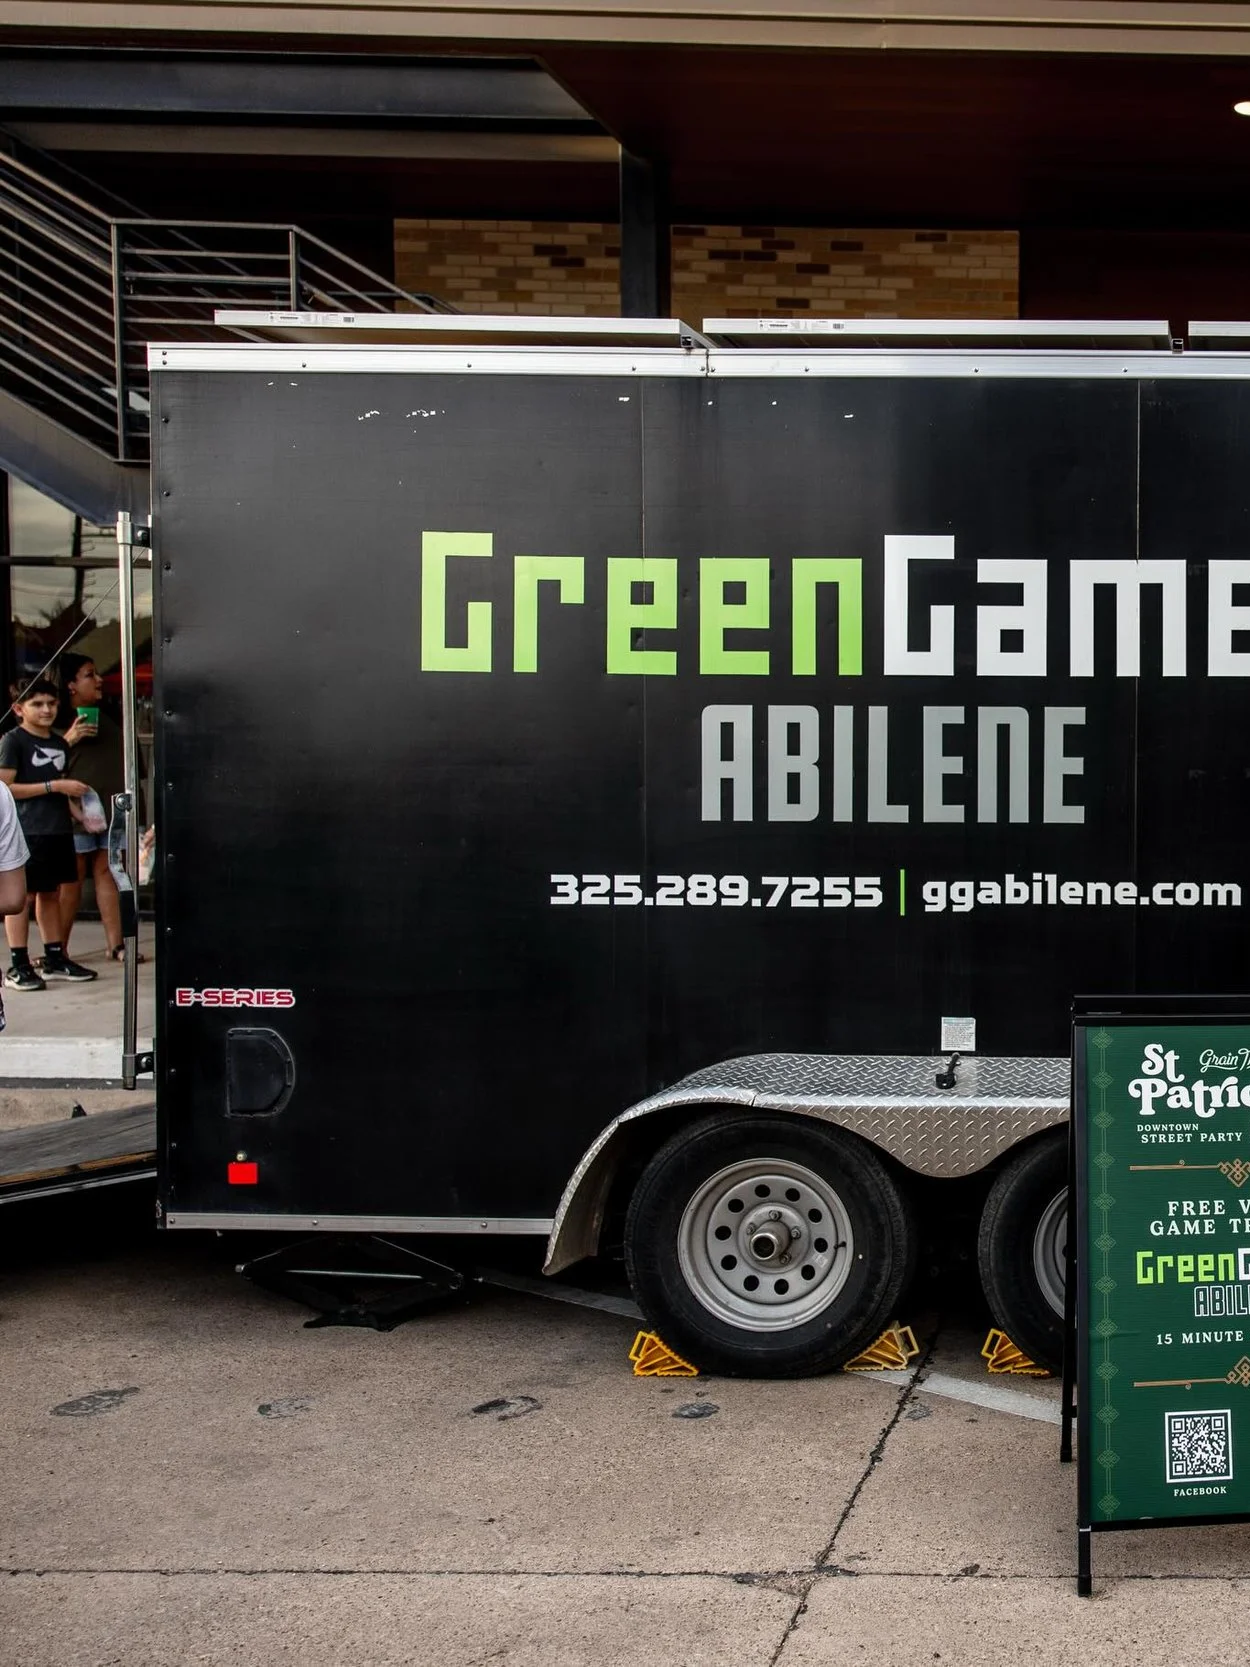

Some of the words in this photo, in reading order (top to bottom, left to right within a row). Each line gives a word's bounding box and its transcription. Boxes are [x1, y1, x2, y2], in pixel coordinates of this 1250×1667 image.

[701, 704, 1087, 823] ABILENE
[550, 873, 883, 908] 325.289.7255
[922, 872, 1242, 913] ggabilene.com
[176, 987, 296, 1008] E-SERIES
[1141, 1043, 1185, 1083] St
[1199, 1048, 1239, 1072] Grain
[1136, 1123, 1199, 1132] DOWNTOWN
[1141, 1133, 1193, 1144] STREET
[1200, 1131, 1243, 1143] PARTY
[1167, 1200, 1226, 1216] FREE
[1150, 1218, 1216, 1237] GAME
[1157, 1333, 1173, 1345] 15
[1181, 1330, 1244, 1344] MINUTE
[1173, 1486, 1227, 1497] FACEBOOK
